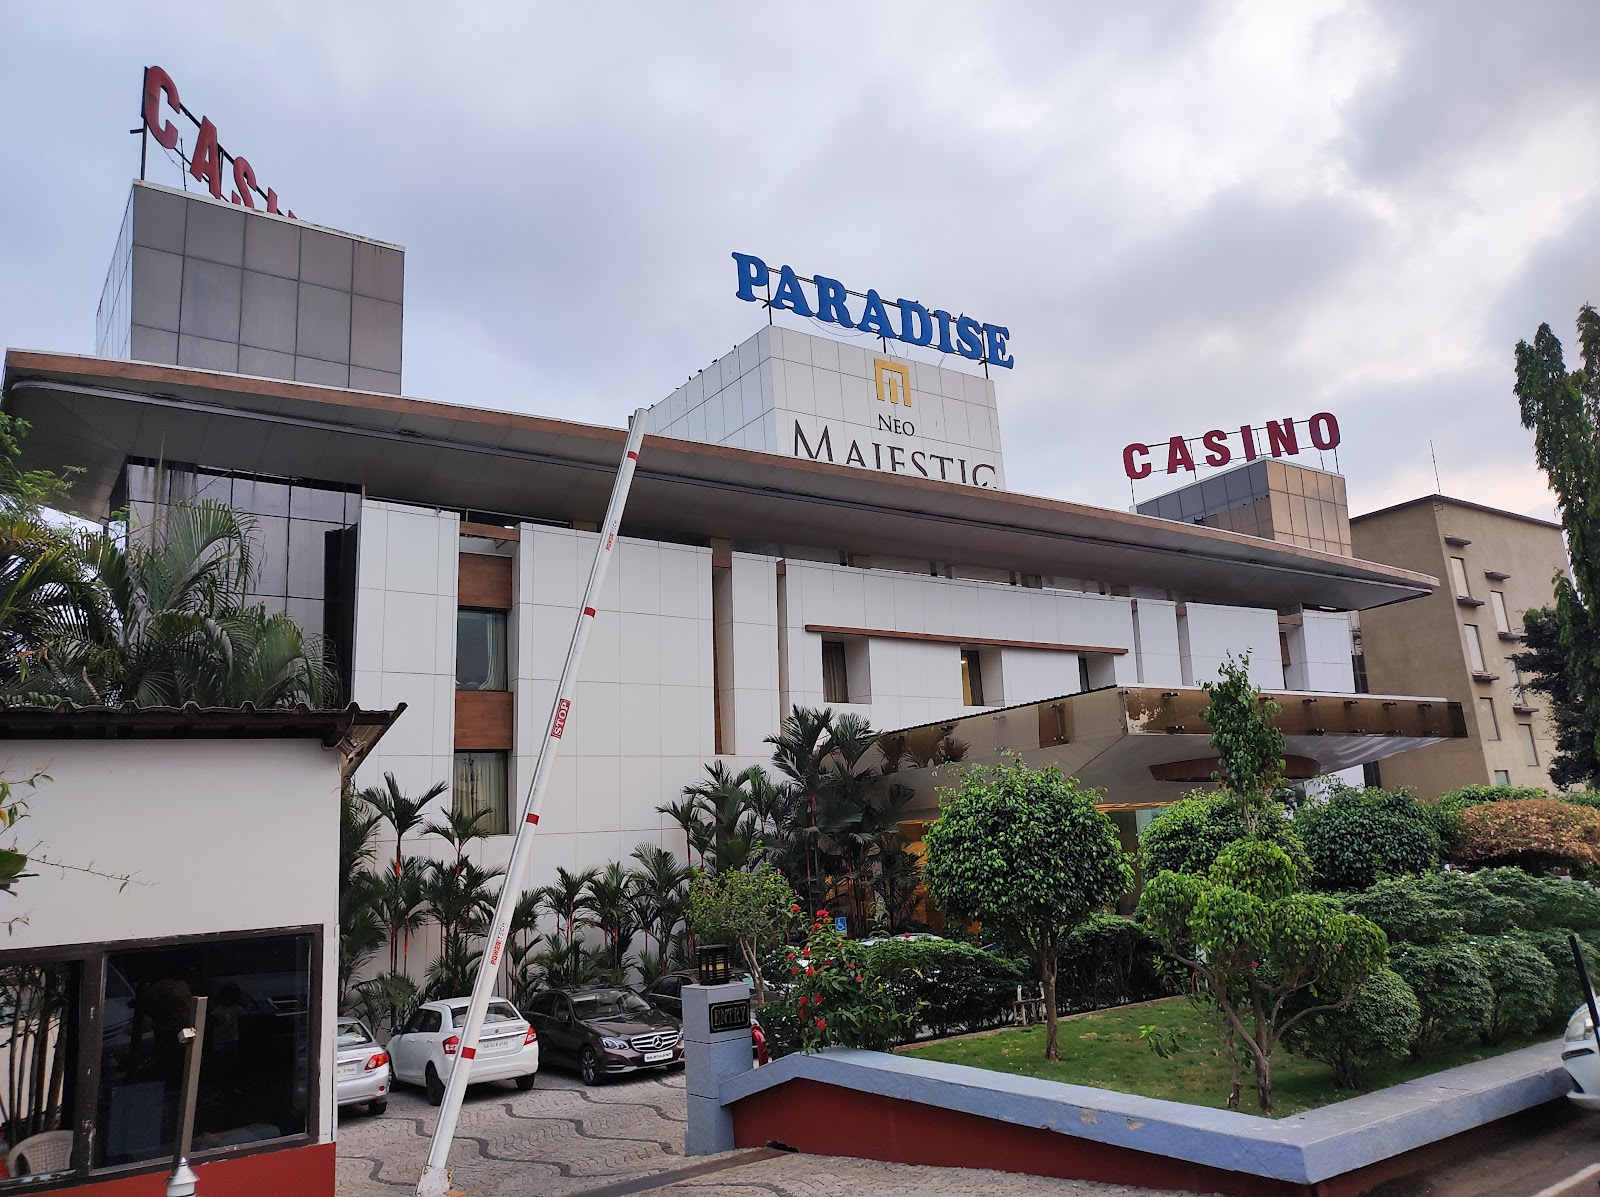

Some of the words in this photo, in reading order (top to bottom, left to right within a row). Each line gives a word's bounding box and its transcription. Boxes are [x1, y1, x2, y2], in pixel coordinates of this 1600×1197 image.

[731, 251, 1015, 369] PARADISE
[878, 413, 915, 436] NEO
[1122, 412, 1341, 480] CASINO
[553, 700, 569, 736] STOP
[490, 941, 501, 965] POWER
[713, 1006, 746, 1026] ENTRY
